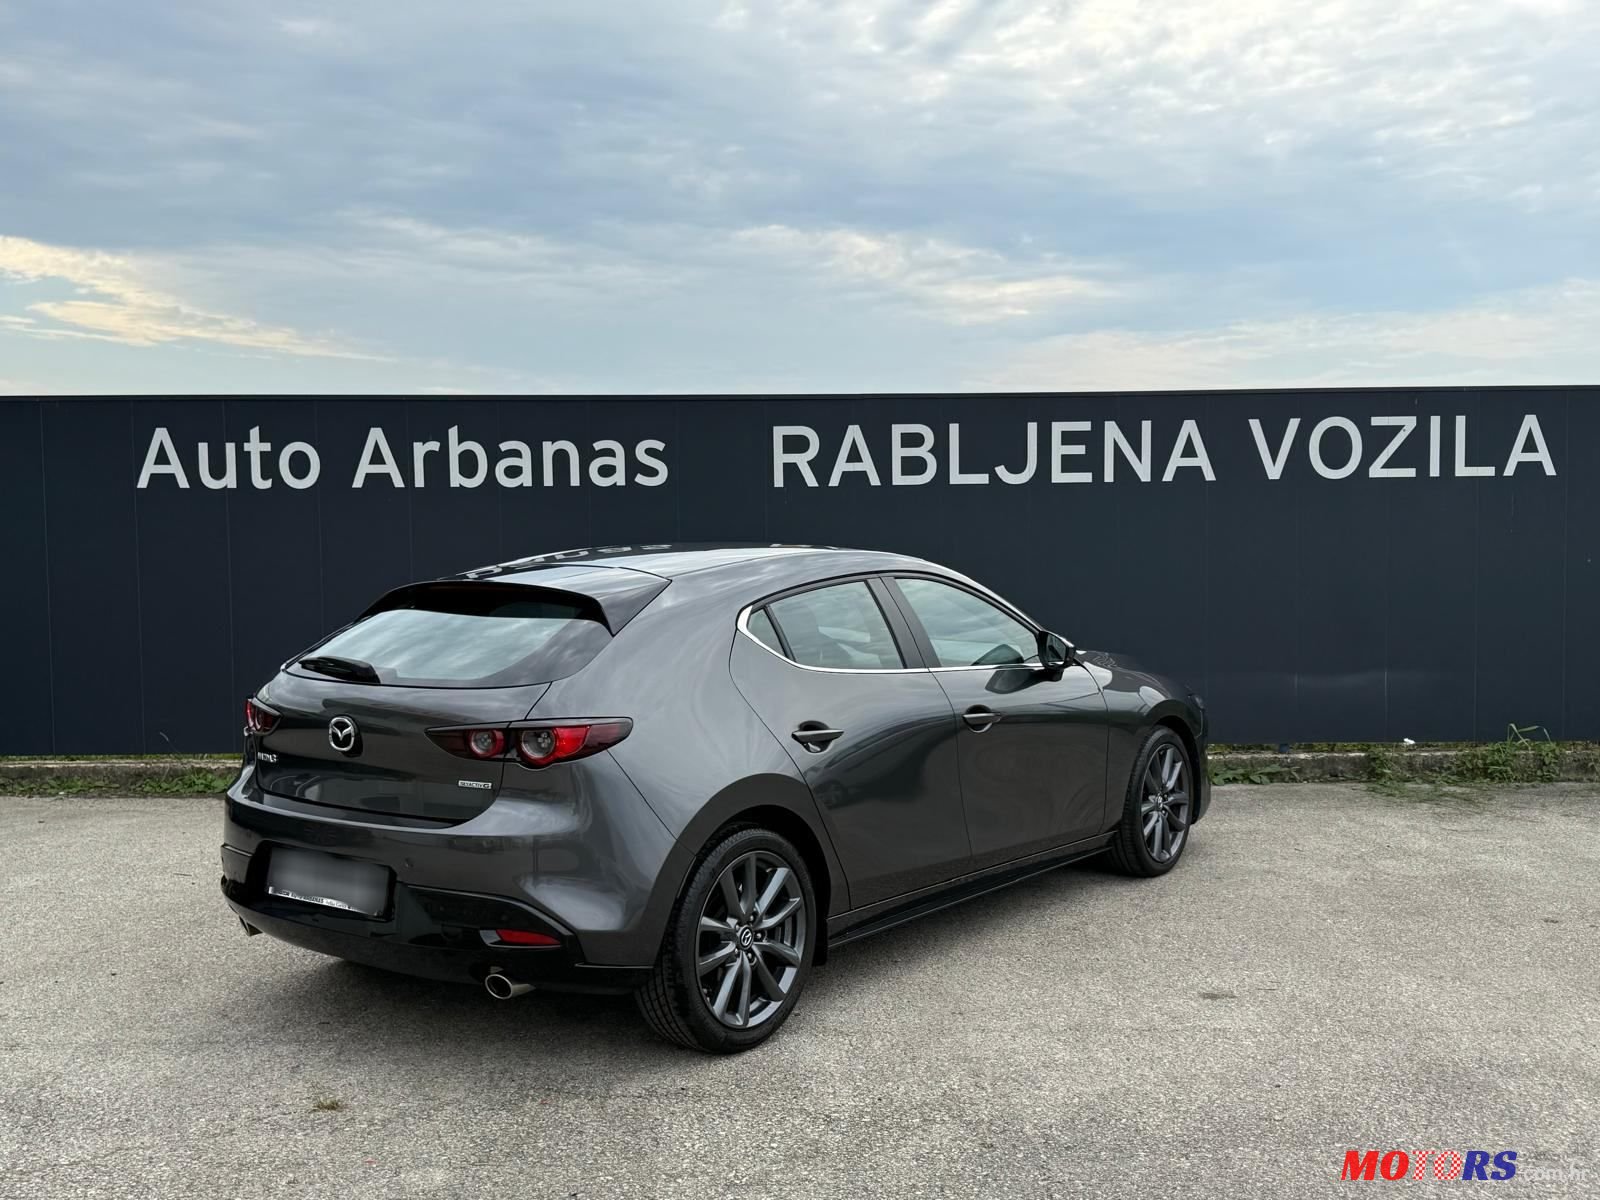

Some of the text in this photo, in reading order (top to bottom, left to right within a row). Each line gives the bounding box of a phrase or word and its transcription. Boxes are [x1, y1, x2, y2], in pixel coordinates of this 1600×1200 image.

[137, 425, 669, 490] Auto Arbanas
[773, 415, 1557, 487] RABLJENA VOZILA
